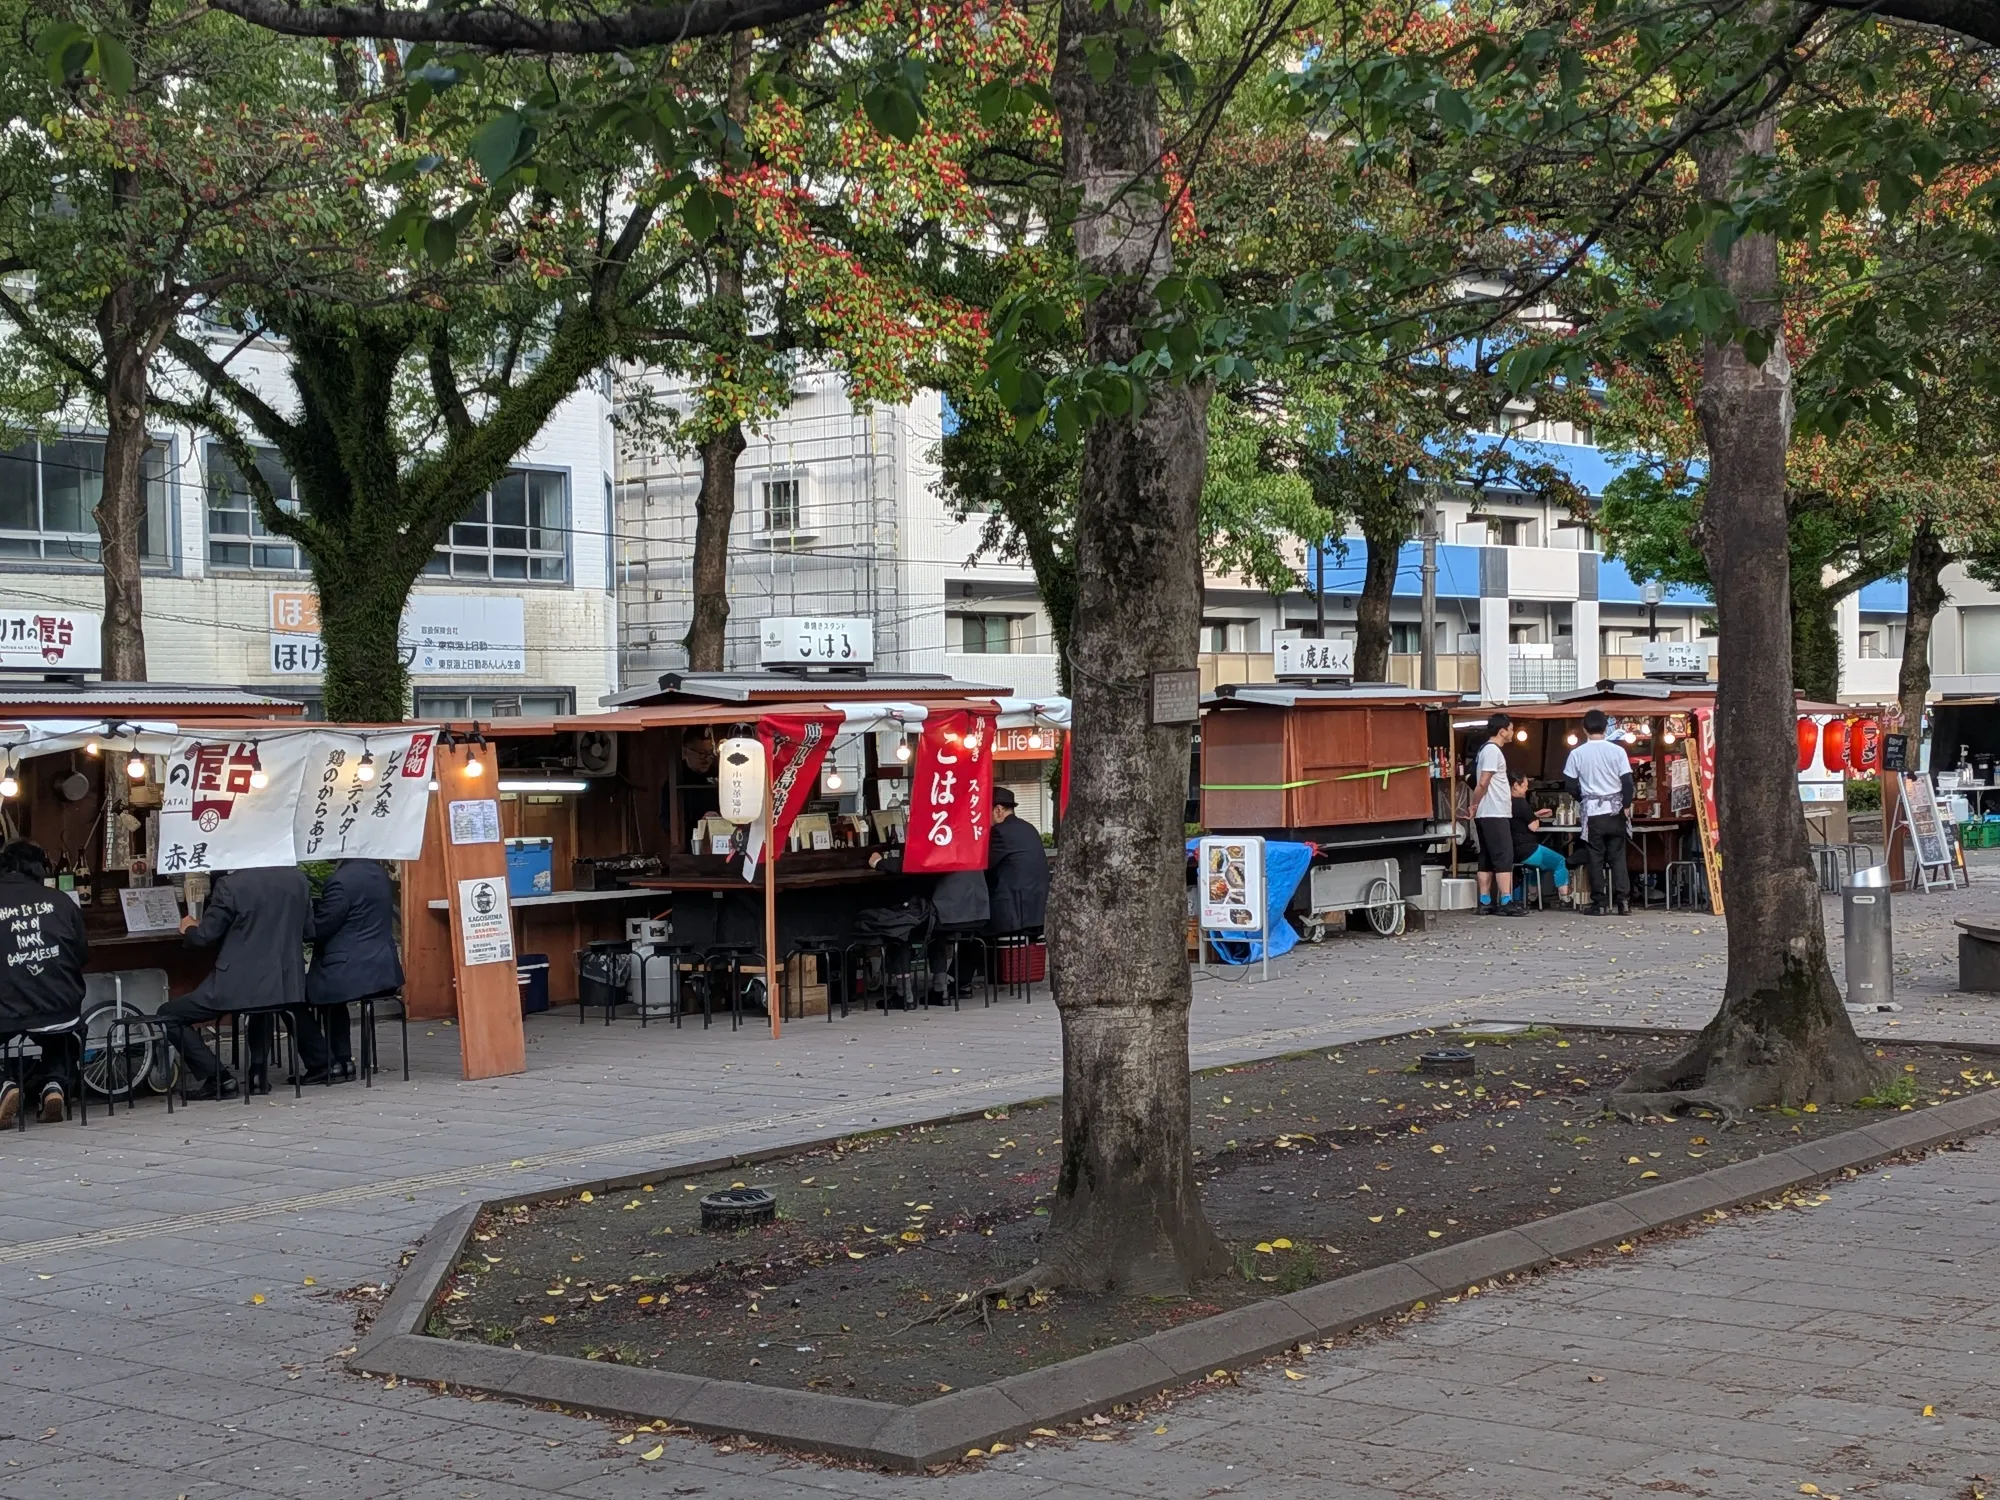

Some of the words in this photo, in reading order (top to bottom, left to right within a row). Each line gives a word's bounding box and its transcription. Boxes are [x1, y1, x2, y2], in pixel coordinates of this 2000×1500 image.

[799, 633, 851, 658] こはる
[438, 659, 521, 670] 東京海上日動あんしん生命
[405, 738, 428, 774] 名物
[998, 729, 1027, 751] Life
[1861, 726, 1877, 764] ラーメン
[371, 750, 402, 818] レタス巻
[927, 732, 959, 846] こはる
[306, 748, 346, 854] 鶏のからあげ
[968, 779, 984, 841] スタンド
[164, 842, 211, 871] 赤星
[468, 913, 503, 923] KAGOSHIMA
[16, 931, 45, 949] MARK
